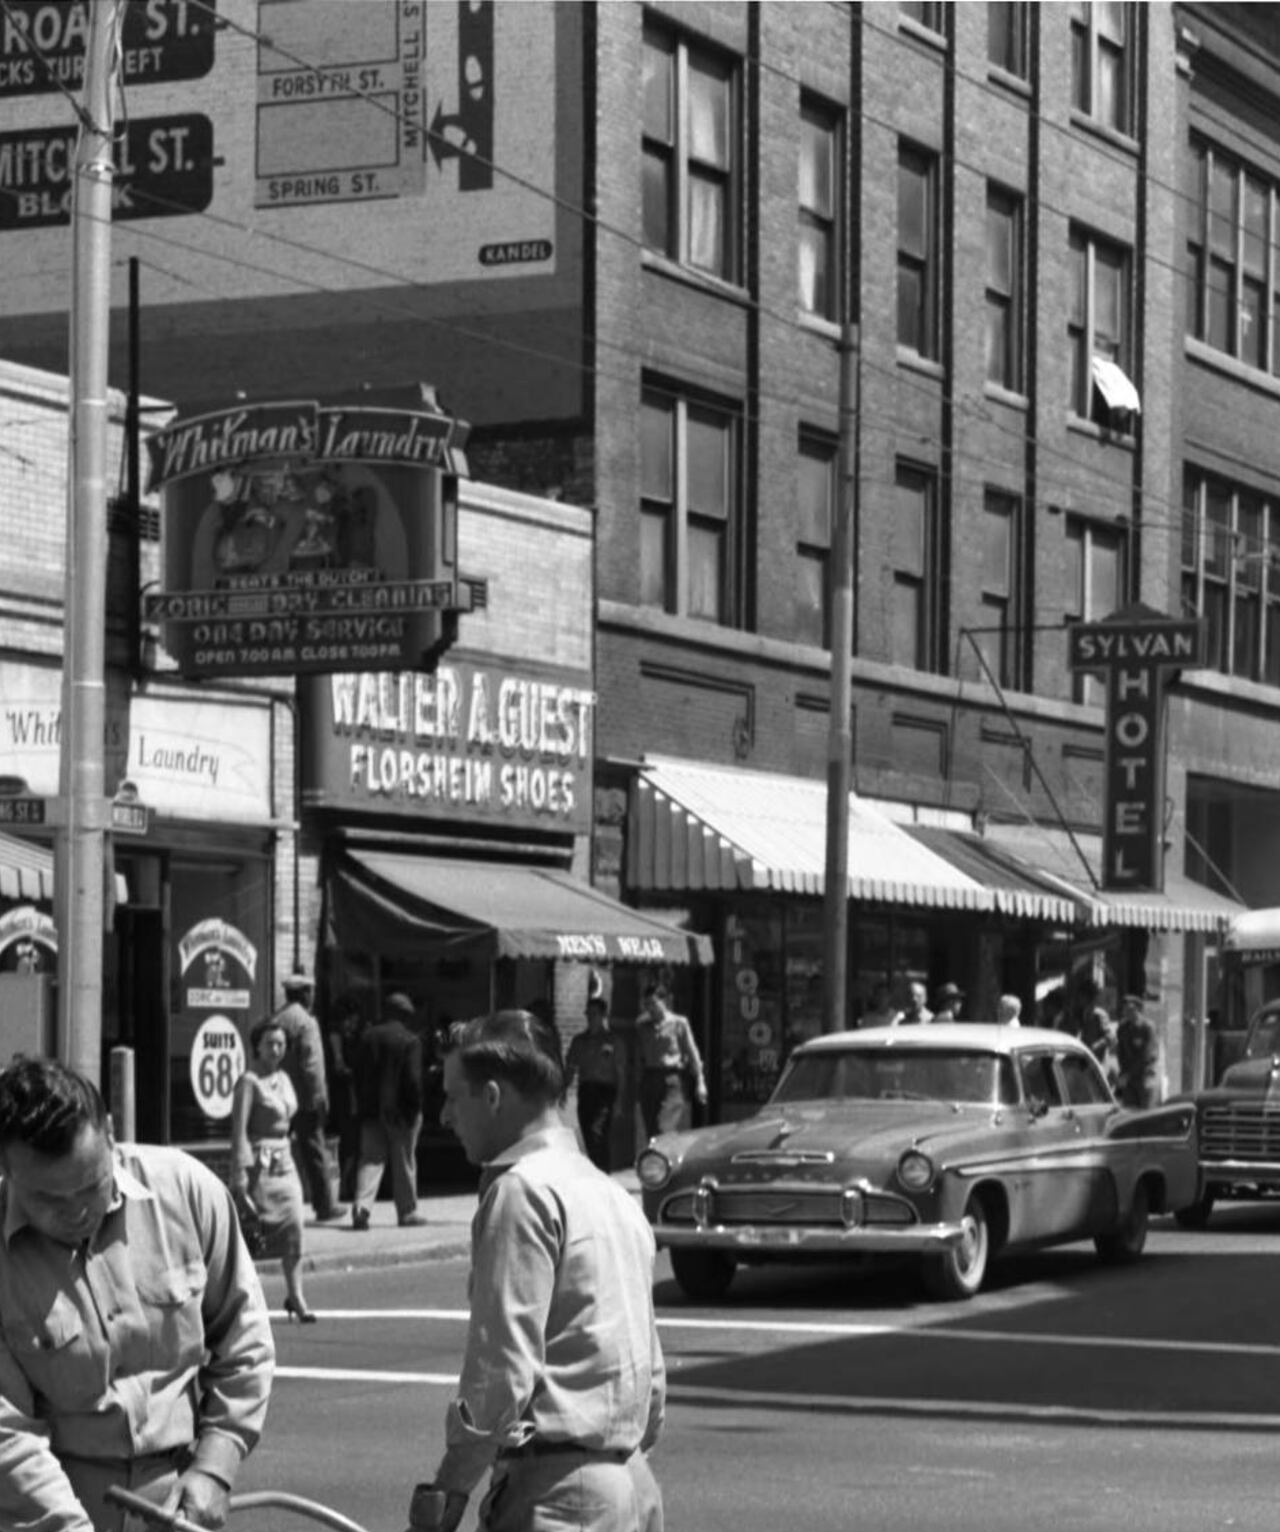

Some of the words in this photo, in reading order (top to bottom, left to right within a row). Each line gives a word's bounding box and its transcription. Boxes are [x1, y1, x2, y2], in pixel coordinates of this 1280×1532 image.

[45, 55, 86, 82] TUR
[123, 47, 163, 74] EFT
[272, 72, 351, 98] FORSYTH
[358, 70, 385, 90] ST.
[402, 30, 420, 149] MITCHELL
[149, 126, 195, 174] ST.
[18, 183, 135, 218] BLK
[269, 178, 340, 200] SPRING
[351, 174, 380, 194] ST.
[484, 243, 548, 261] KANDEL
[160, 410, 318, 482] Whitman's
[321, 413, 447, 468] Laundry
[194, 622, 242, 644] ONE
[249, 619, 298, 642] DAY
[1078, 632, 1193, 659] SYLVAN
[195, 651, 235, 665] OPEN
[300, 645, 348, 661] CLOSE
[331, 666, 459, 739] WALTER
[499, 677, 596, 758] GUEST
[138, 735, 221, 785] Laundry
[1115, 668, 1149, 879] HOTEL
[350, 743, 493, 804] FLORSHEIM
[499, 764, 577, 813] SHOES
[617, 935, 665, 958] WEAR
[203, 1033, 236, 1050] SUITS
